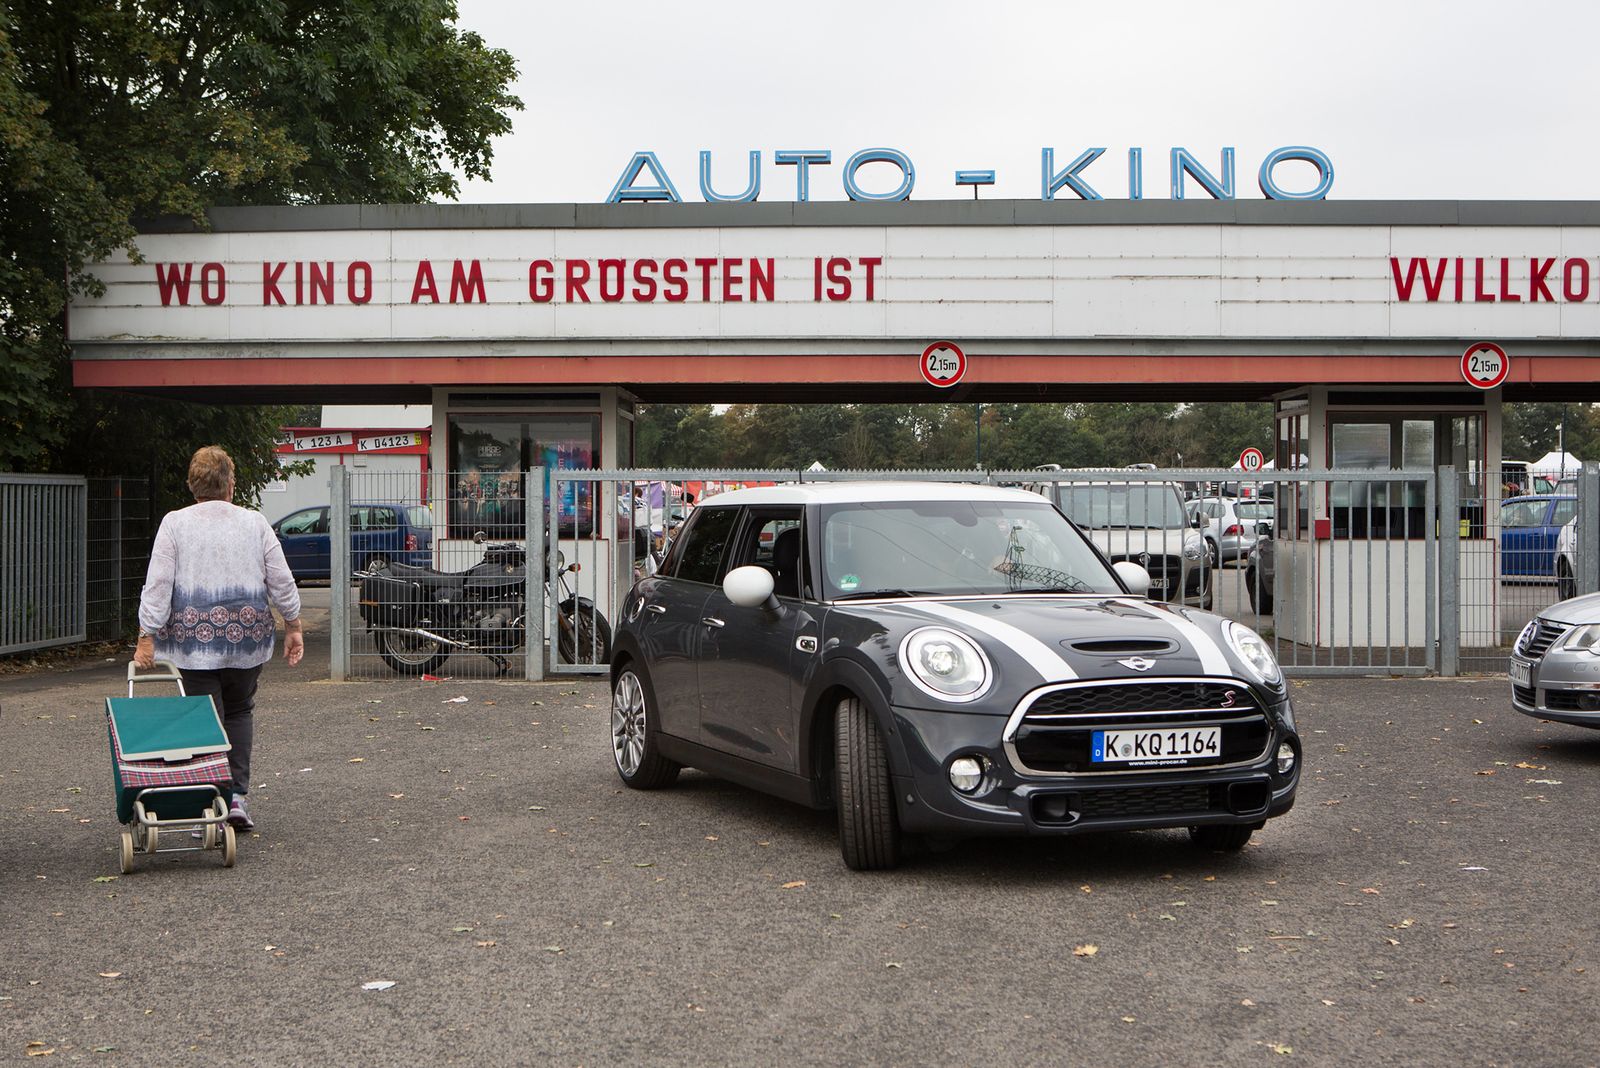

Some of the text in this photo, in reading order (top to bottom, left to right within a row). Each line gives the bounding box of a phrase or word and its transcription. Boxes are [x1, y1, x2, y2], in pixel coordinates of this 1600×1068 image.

[605, 148, 916, 203] AUTO
[1042, 146, 1335, 201] KINO
[156, 263, 225, 305] WO
[263, 261, 373, 305] KINO
[411, 260, 487, 304] AM
[814, 256, 882, 301] IST
[1390, 257, 1600, 302] WILLKO
[296, 435, 343, 449] K 123 A
[360, 440, 367, 450] K
[375, 435, 409, 449] 04123
[1246, 455, 1257, 467] 10
[1128, 759, 1188, 767] www.mini-procar.de
